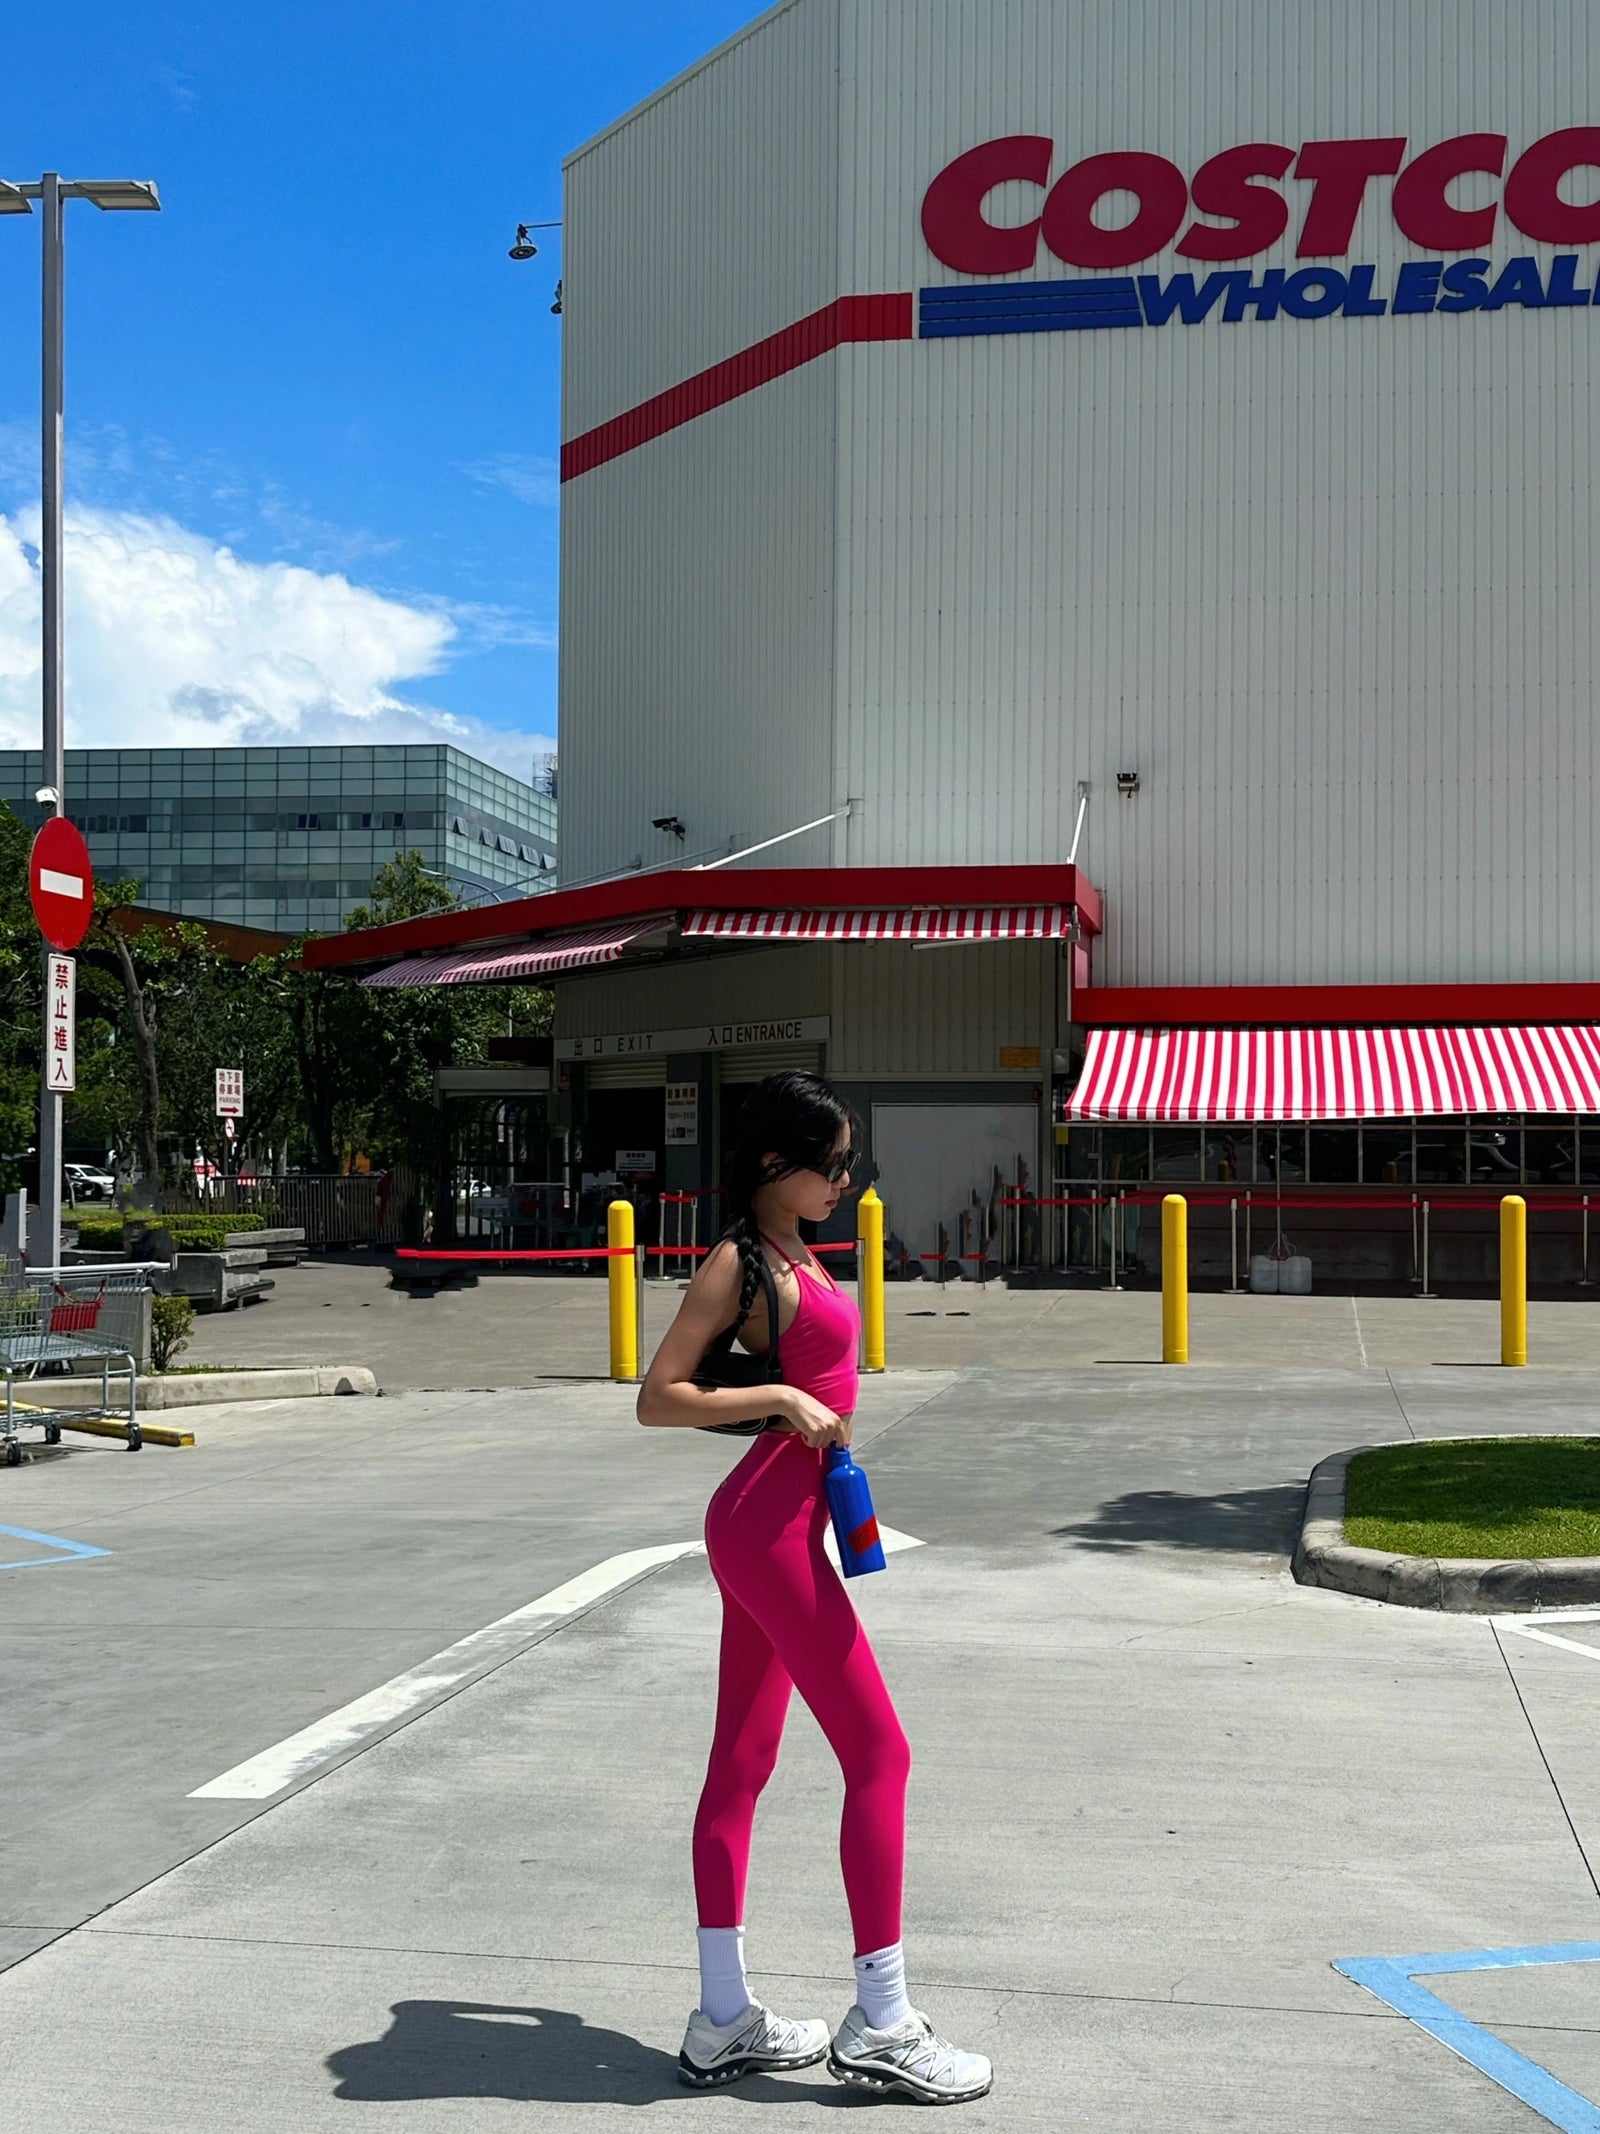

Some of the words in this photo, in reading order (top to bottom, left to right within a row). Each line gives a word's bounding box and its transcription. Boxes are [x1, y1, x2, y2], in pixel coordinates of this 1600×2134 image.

[921, 126, 1600, 275] COSTCO
[1137, 254, 1600, 326] WHOLESAL
[54, 963, 69, 1081] 禁止進入
[574, 1039, 603, 1056] 出口
[618, 1035, 653, 1052] EXIT
[708, 1028, 733, 1046] 入口
[736, 1022, 802, 1043] ENTRANCE
